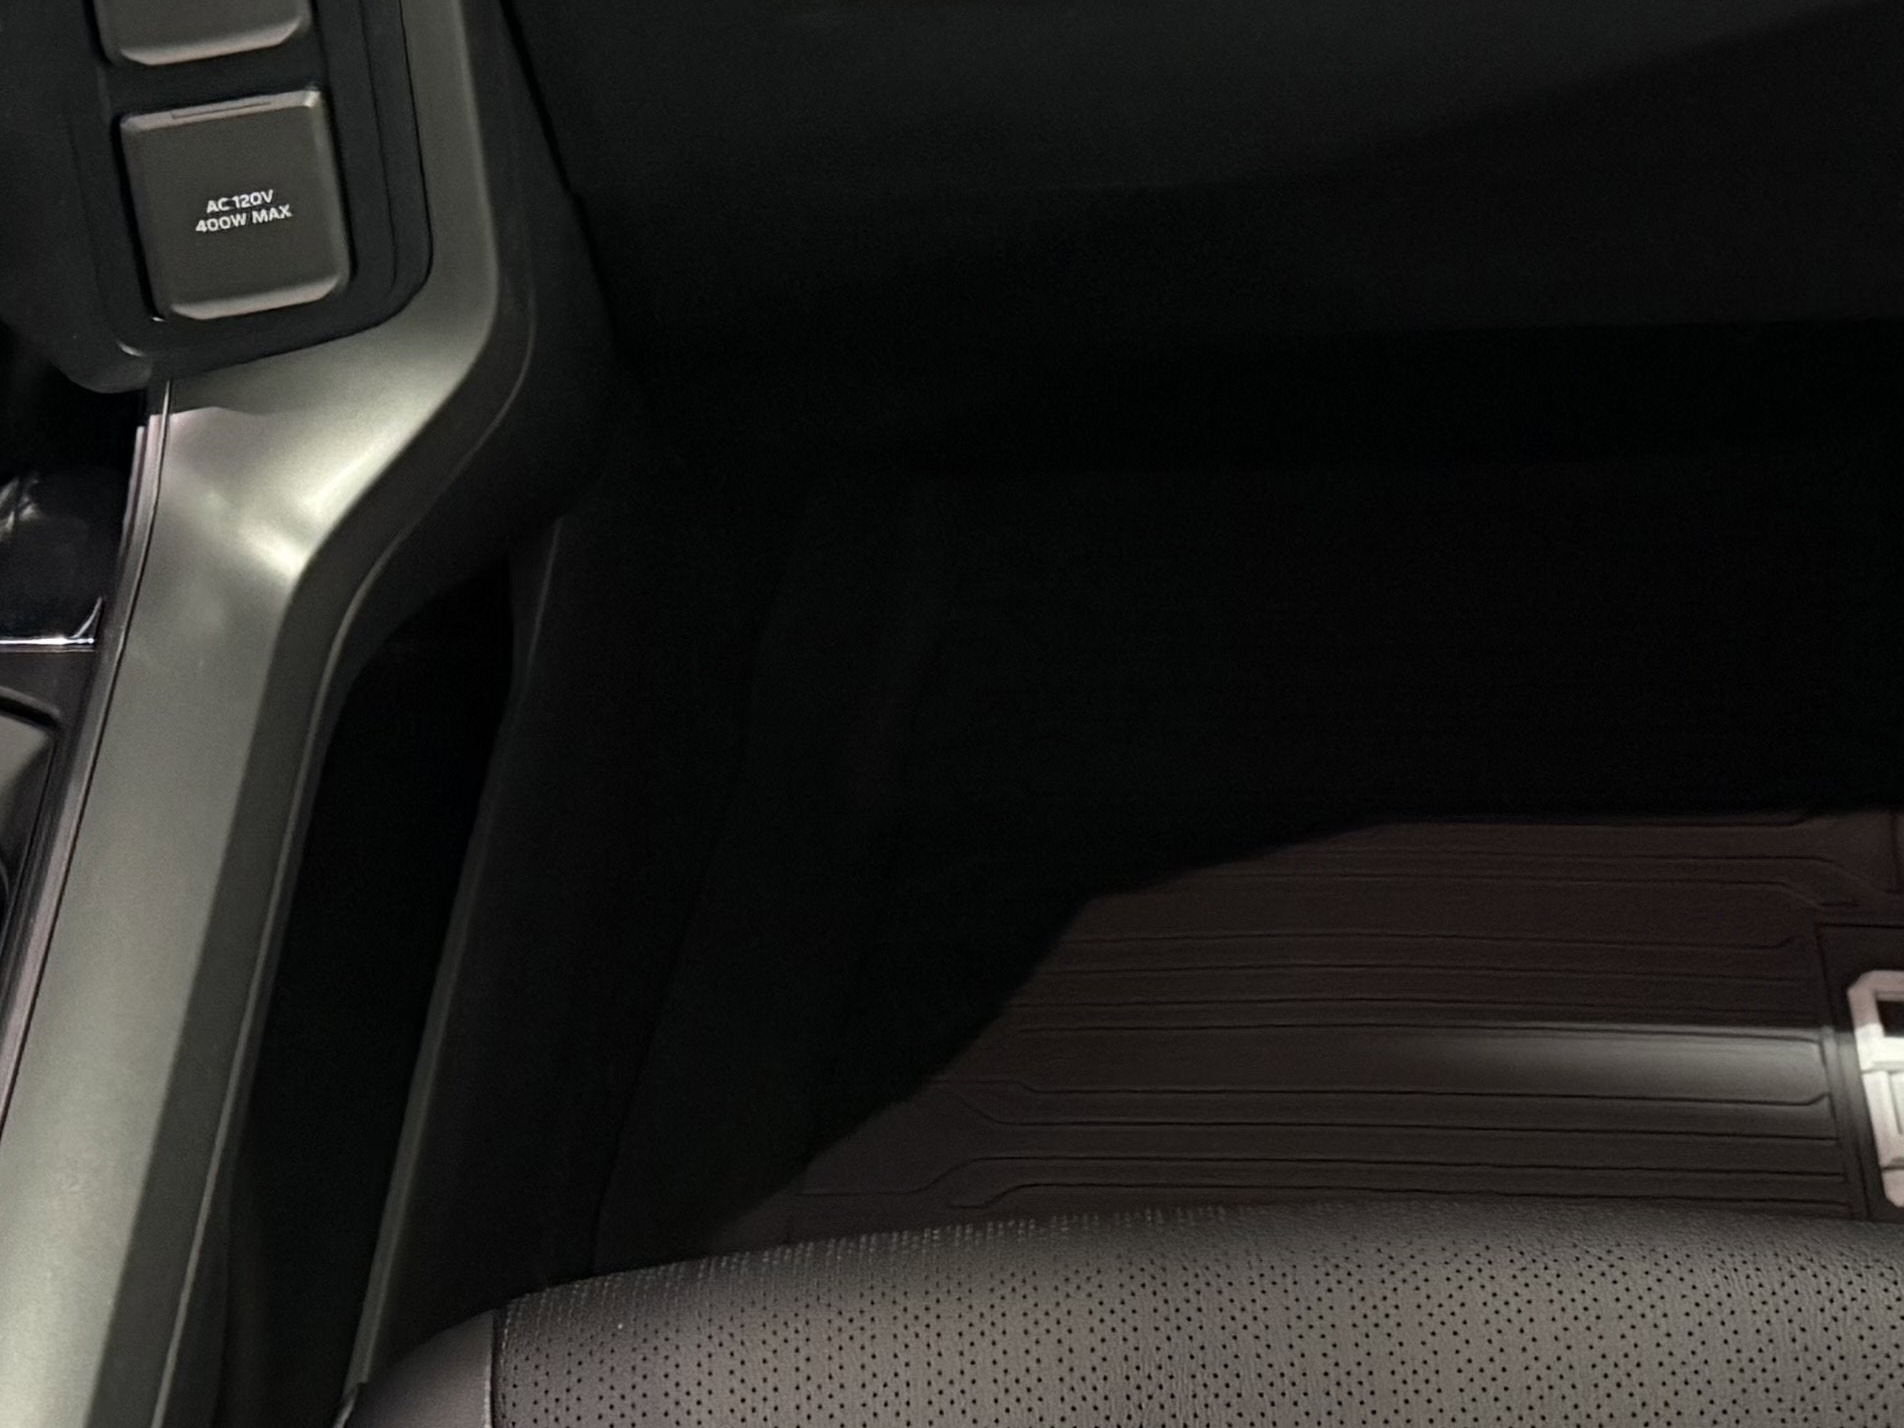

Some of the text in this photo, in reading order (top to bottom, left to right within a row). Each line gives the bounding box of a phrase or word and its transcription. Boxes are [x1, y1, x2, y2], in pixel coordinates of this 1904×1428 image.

[206, 189, 274, 214] AC 120V
[195, 204, 293, 233] 400W MAX
